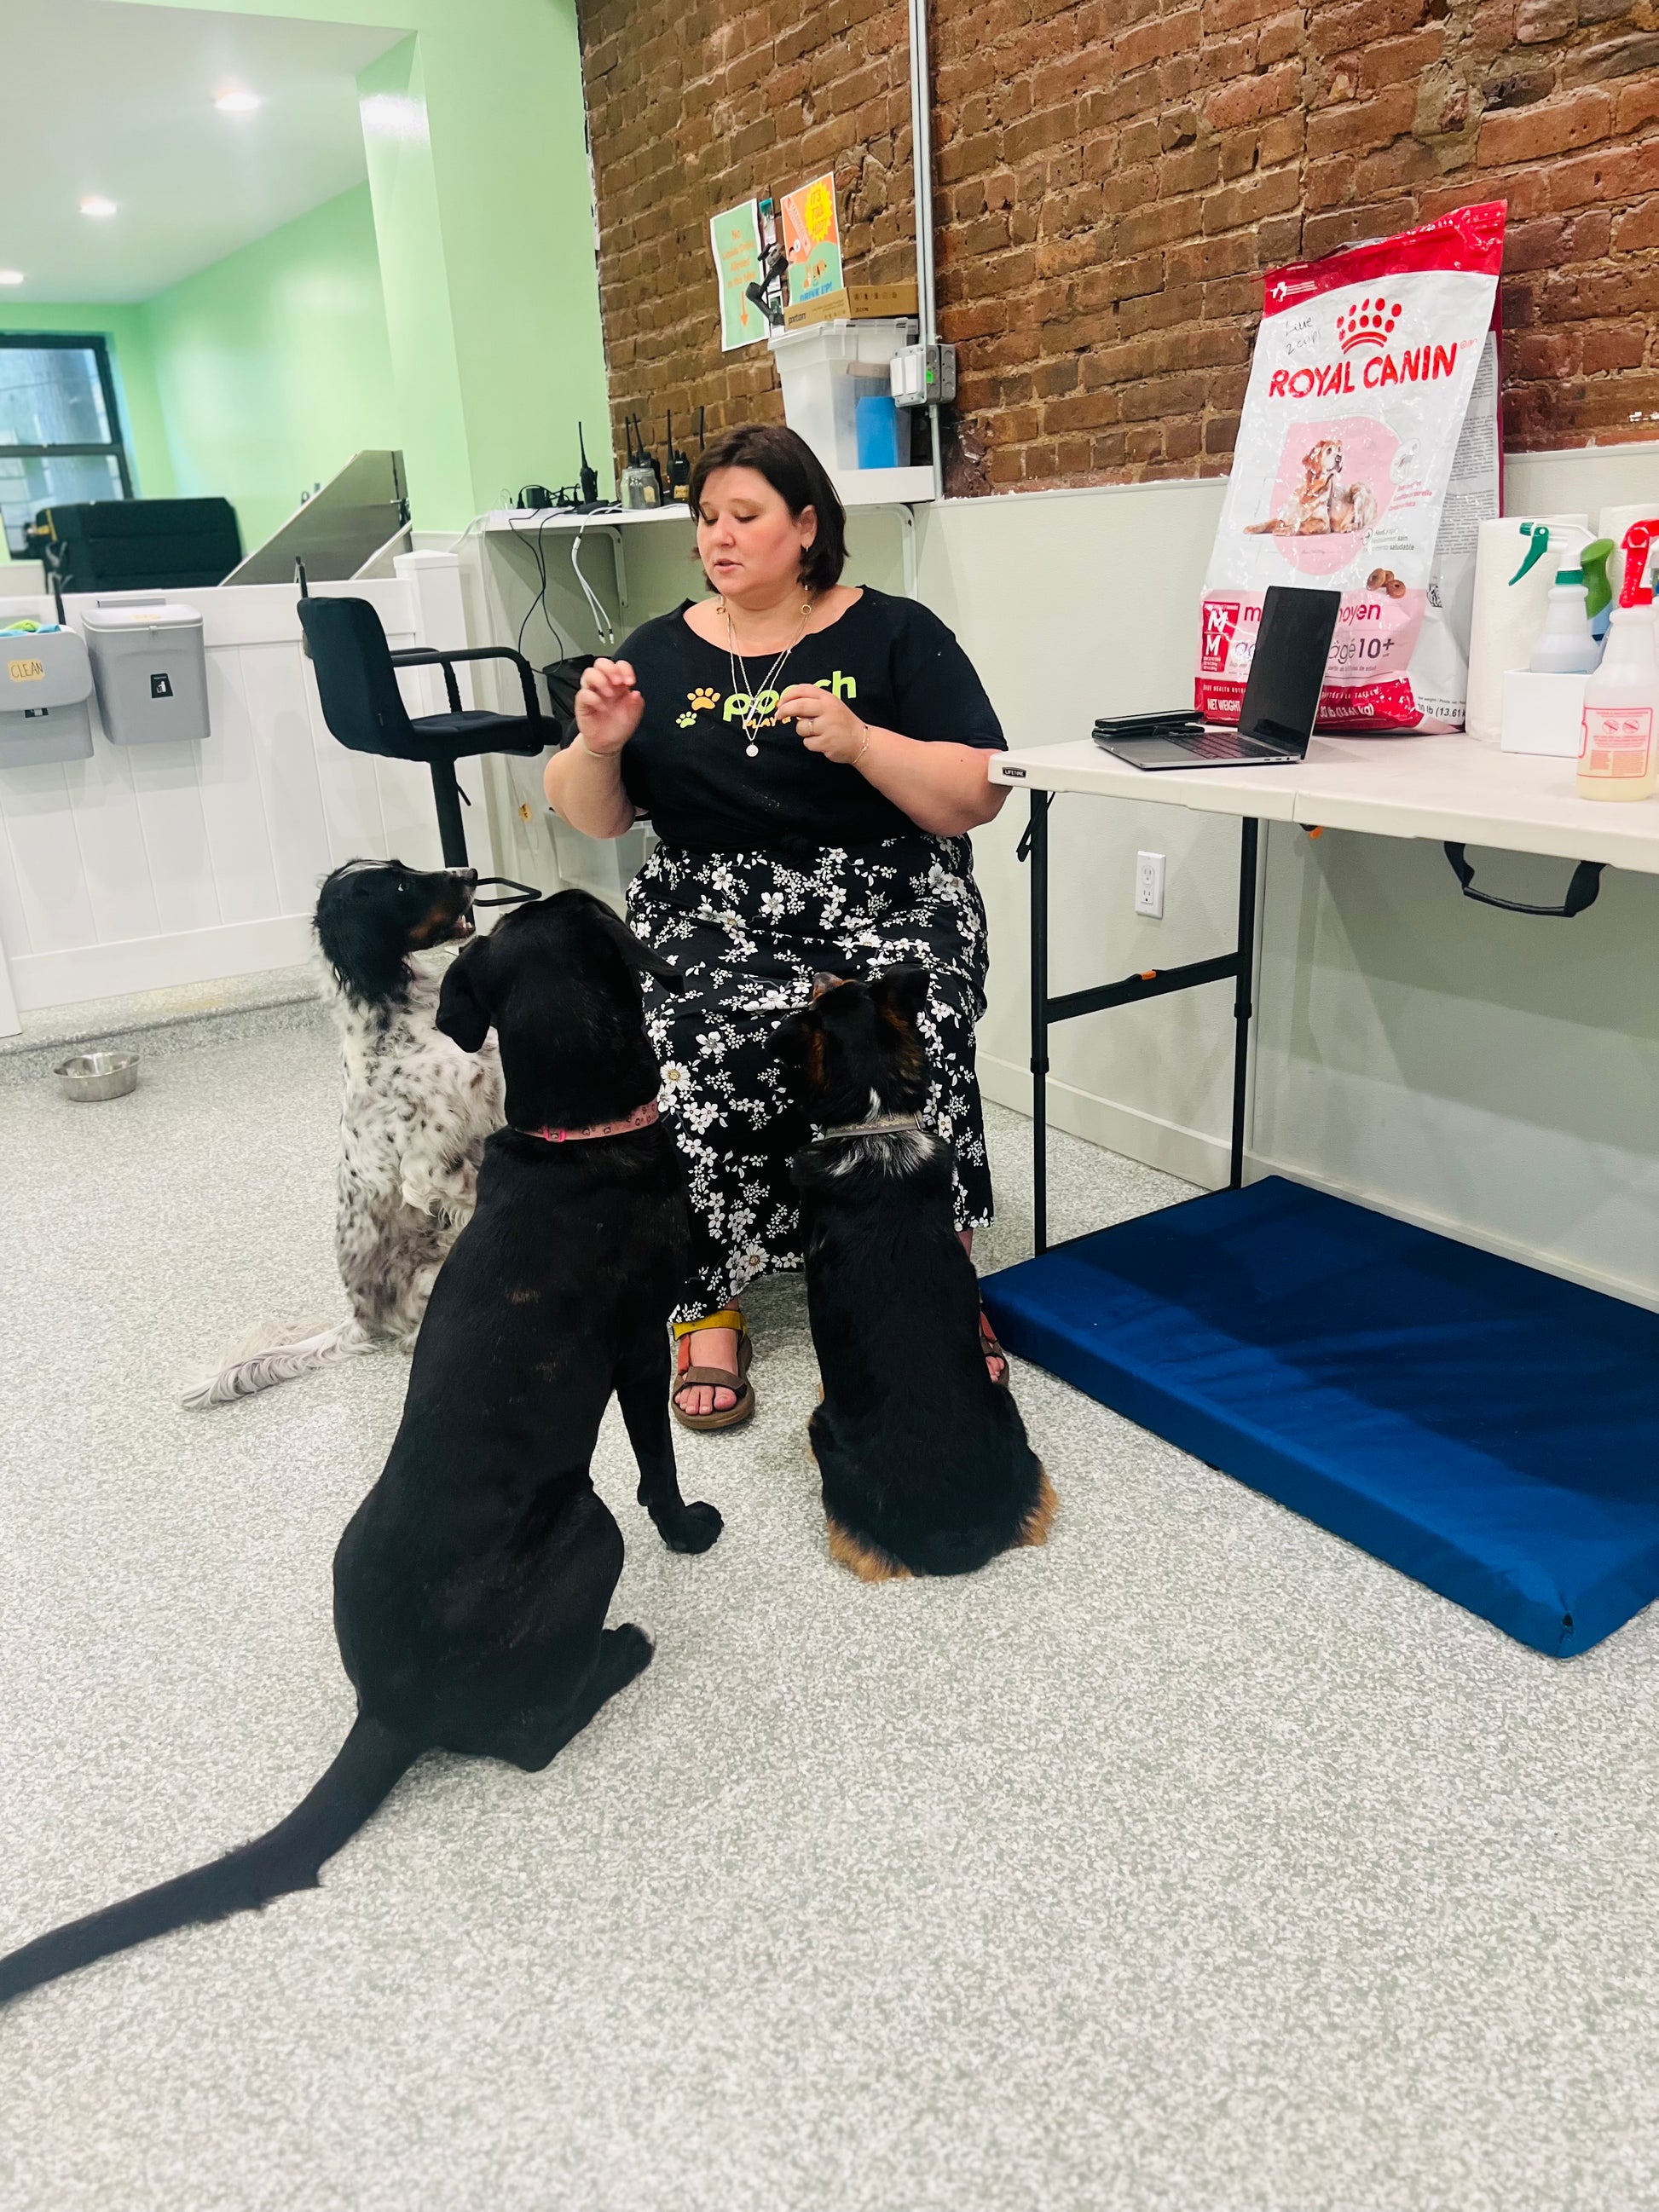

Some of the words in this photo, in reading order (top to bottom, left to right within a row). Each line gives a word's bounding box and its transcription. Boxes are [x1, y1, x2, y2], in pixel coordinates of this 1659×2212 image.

[800, 287, 819, 302] DRINK
[821, 280, 833, 295] UP!
[1286, 344, 1295, 355] 2
[1269, 361, 1355, 398] ROYAL
[1363, 343, 1457, 389] CANIN
[11, 661, 43, 678] CLEAN
[723, 670, 857, 722] poh
[1207, 698, 1217, 710] NET
[1218, 699, 1241, 712] WEIGHT
[1426, 705, 1433, 714] lb
[1436, 707, 1461, 718] (13.61
